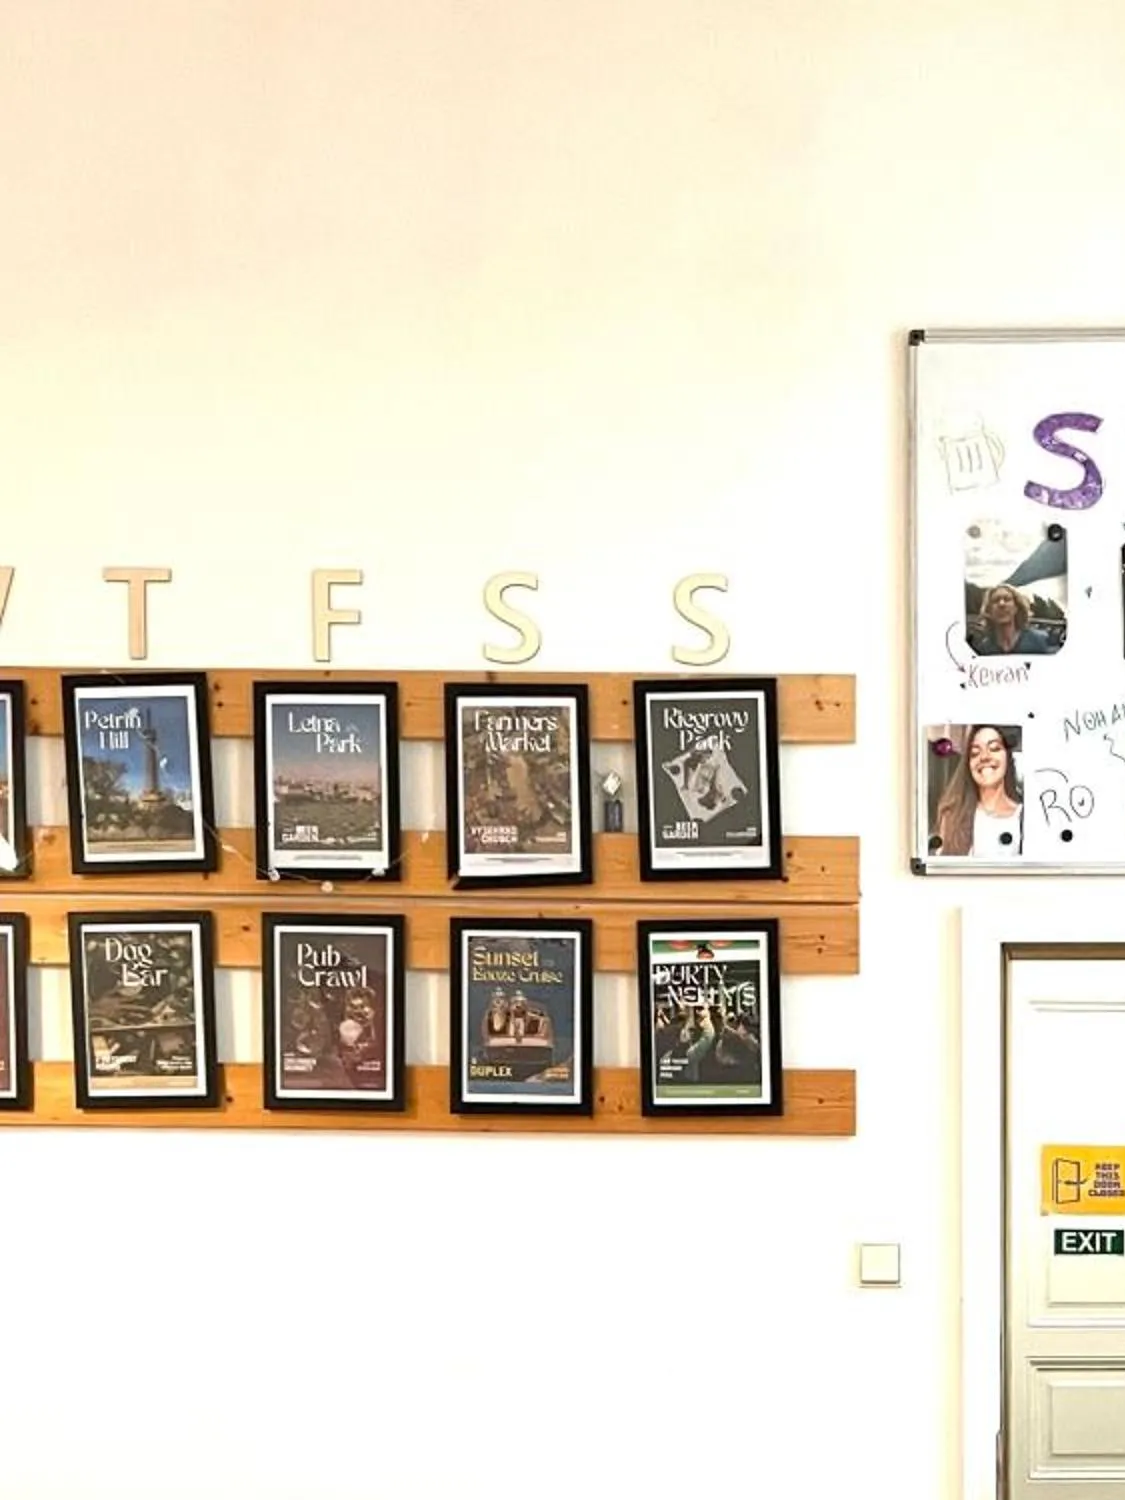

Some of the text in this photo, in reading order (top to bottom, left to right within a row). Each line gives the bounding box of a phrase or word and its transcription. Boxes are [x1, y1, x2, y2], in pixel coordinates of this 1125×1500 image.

[102, 567, 173, 661] T
[310, 568, 363, 663] F
[482, 570, 543, 665] S
[670, 571, 731, 667] S
[474, 710, 559, 732] Farmers
[662, 707, 749, 733] Riegrovy
[316, 732, 362, 753] Park
[485, 731, 552, 753] Market
[104, 936, 154, 966] Dog
[297, 943, 341, 967] Pub
[472, 945, 540, 967] Sunset
[298, 964, 369, 988] Crawl
[1061, 1231, 1118, 1252] EXIT
